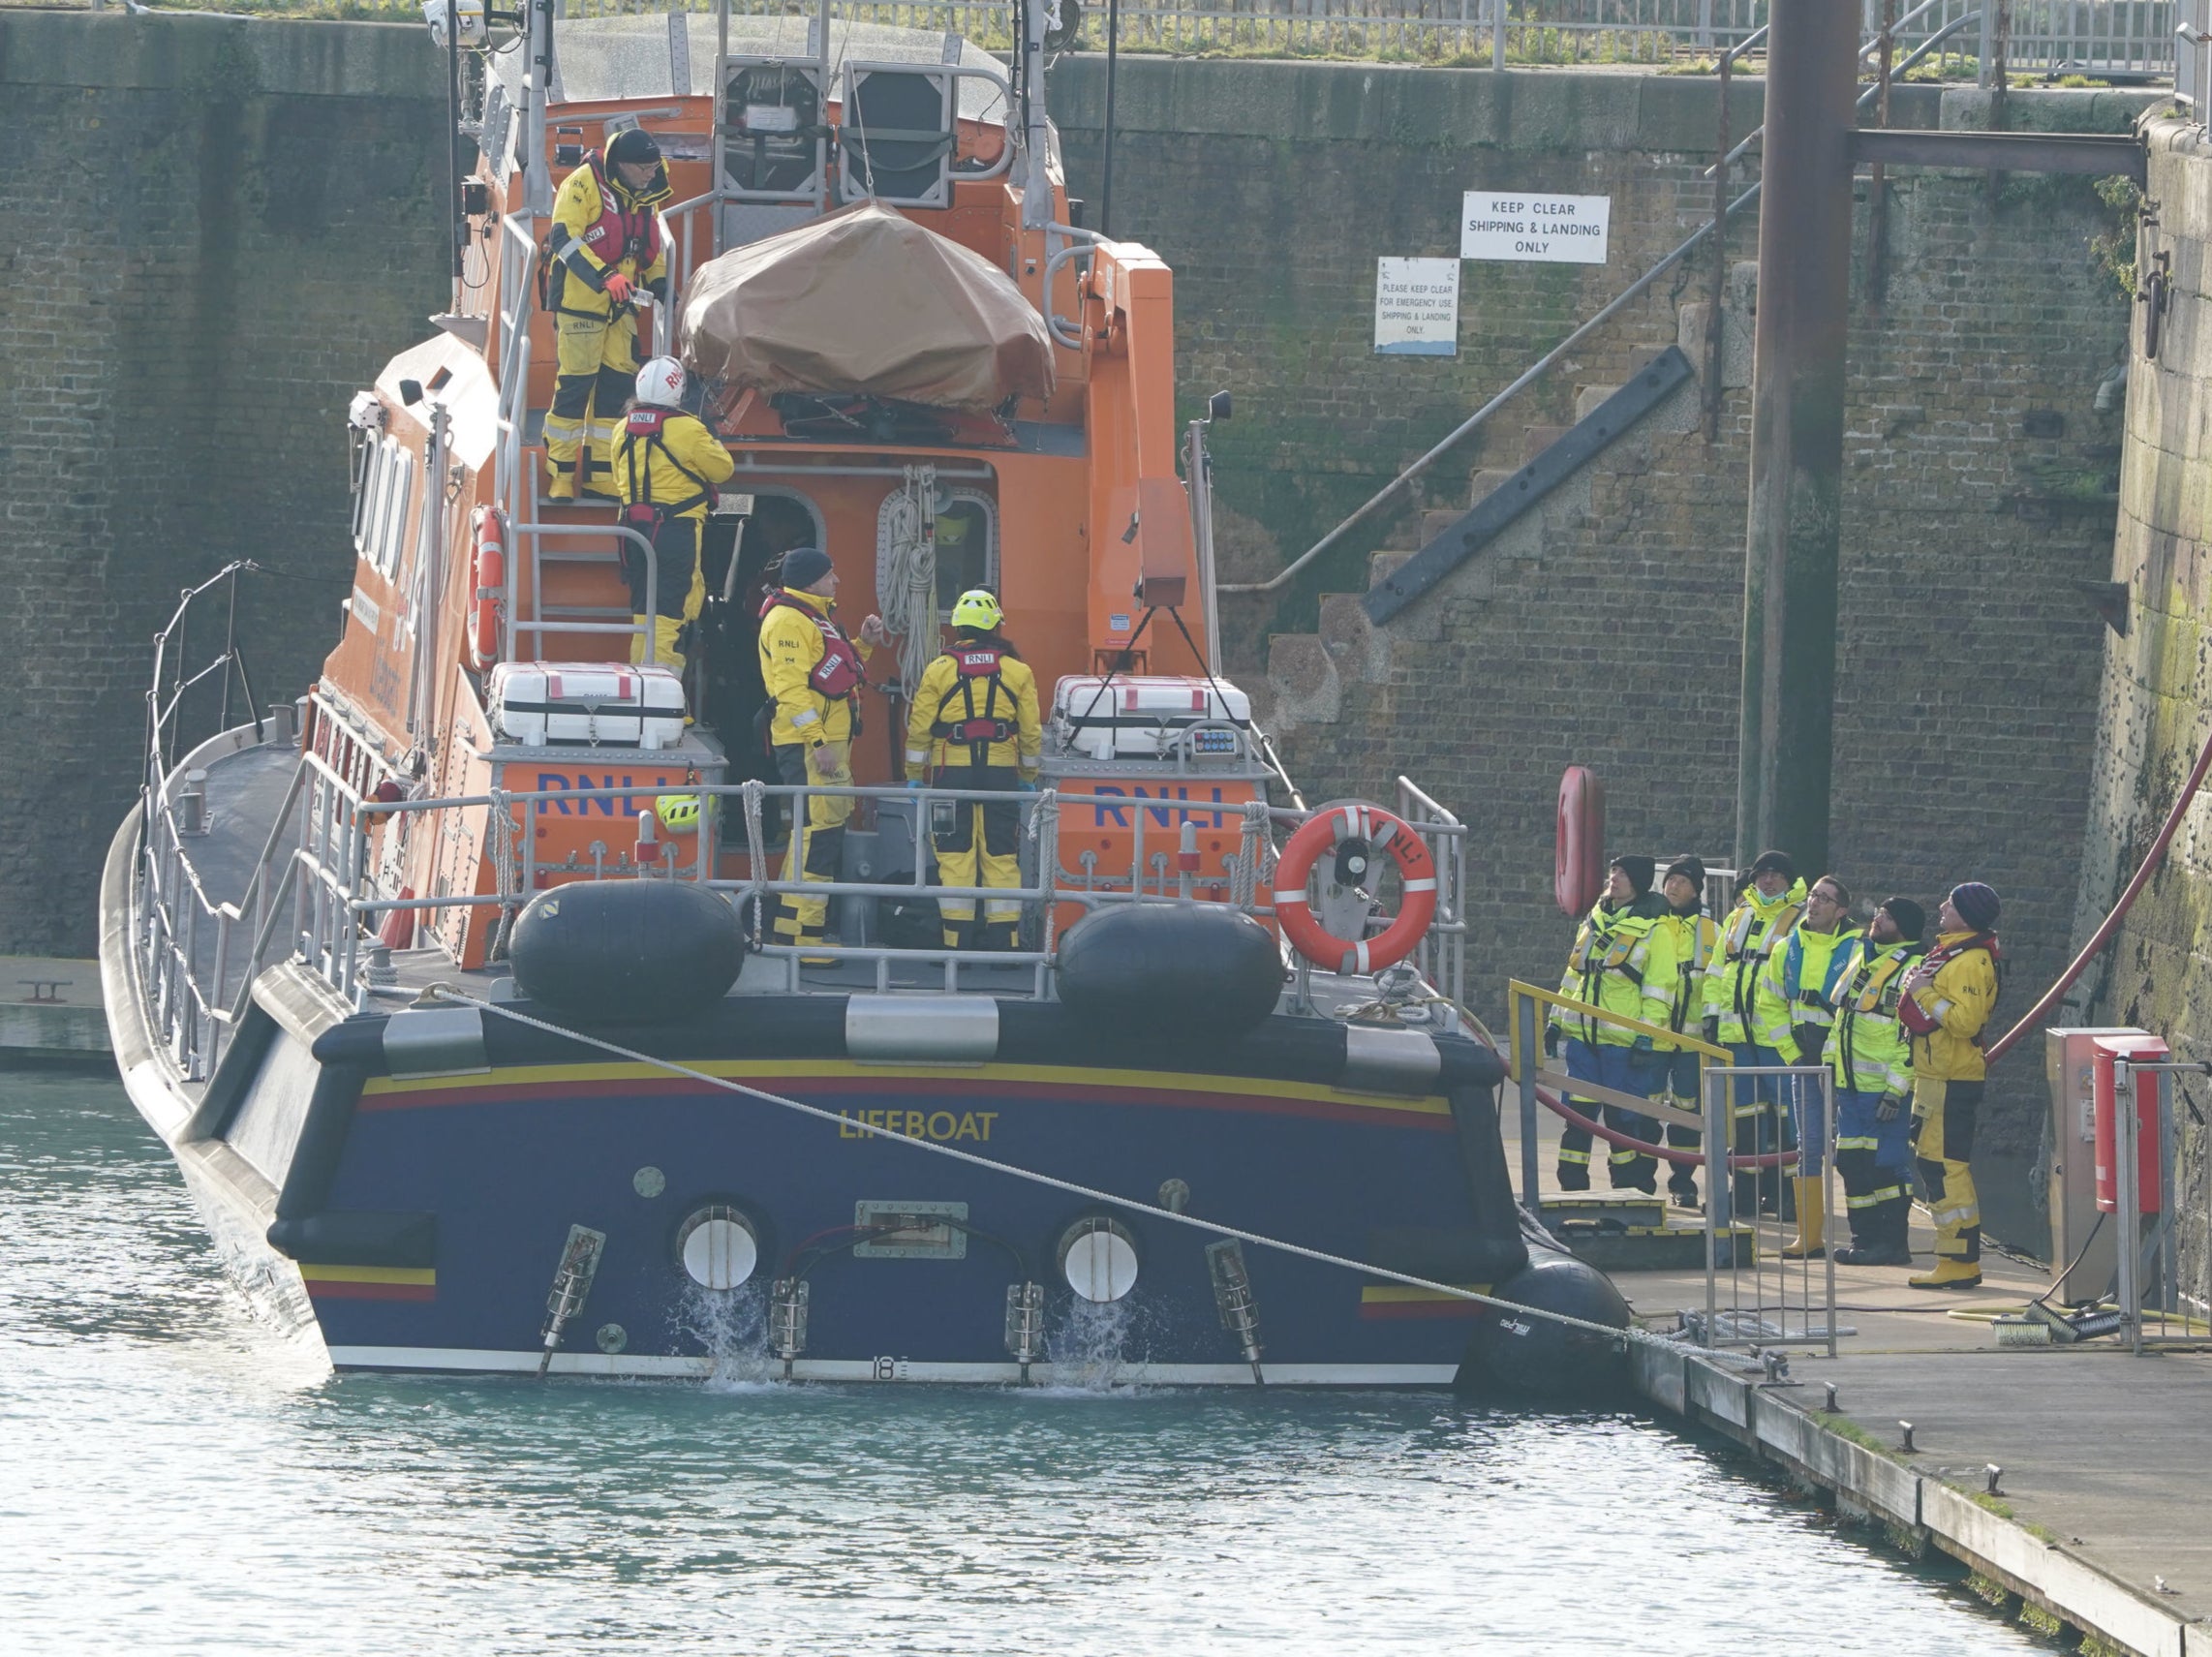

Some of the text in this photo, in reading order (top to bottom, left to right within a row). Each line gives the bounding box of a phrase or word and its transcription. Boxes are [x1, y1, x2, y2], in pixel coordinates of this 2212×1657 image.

[1491, 200, 1576, 215] KEEP CLEAR
[1468, 220, 1601, 236] SHIPPING & LANDING
[1515, 241, 1550, 254] ONLY
[1383, 284, 1453, 294] PLEASE KEEP CLEAR
[1380, 297, 1394, 306] FOR
[1397, 297, 1436, 307] EMERGENCY
[1382, 311, 1412, 321] SHIPPING
[1422, 312, 1451, 322] LANDING
[632, 414, 654, 422] RNLI
[779, 640, 800, 649] RNLI
[968, 654, 992, 664] RNLI
[821, 656, 840, 676] RNLI
[538, 773, 667, 817] RNL
[1094, 785, 1223, 829] RNLI
[1962, 985, 1982, 997] RNLI
[839, 1109, 999, 1141] LIFEBOAT
[874, 1356, 895, 1380] 18
